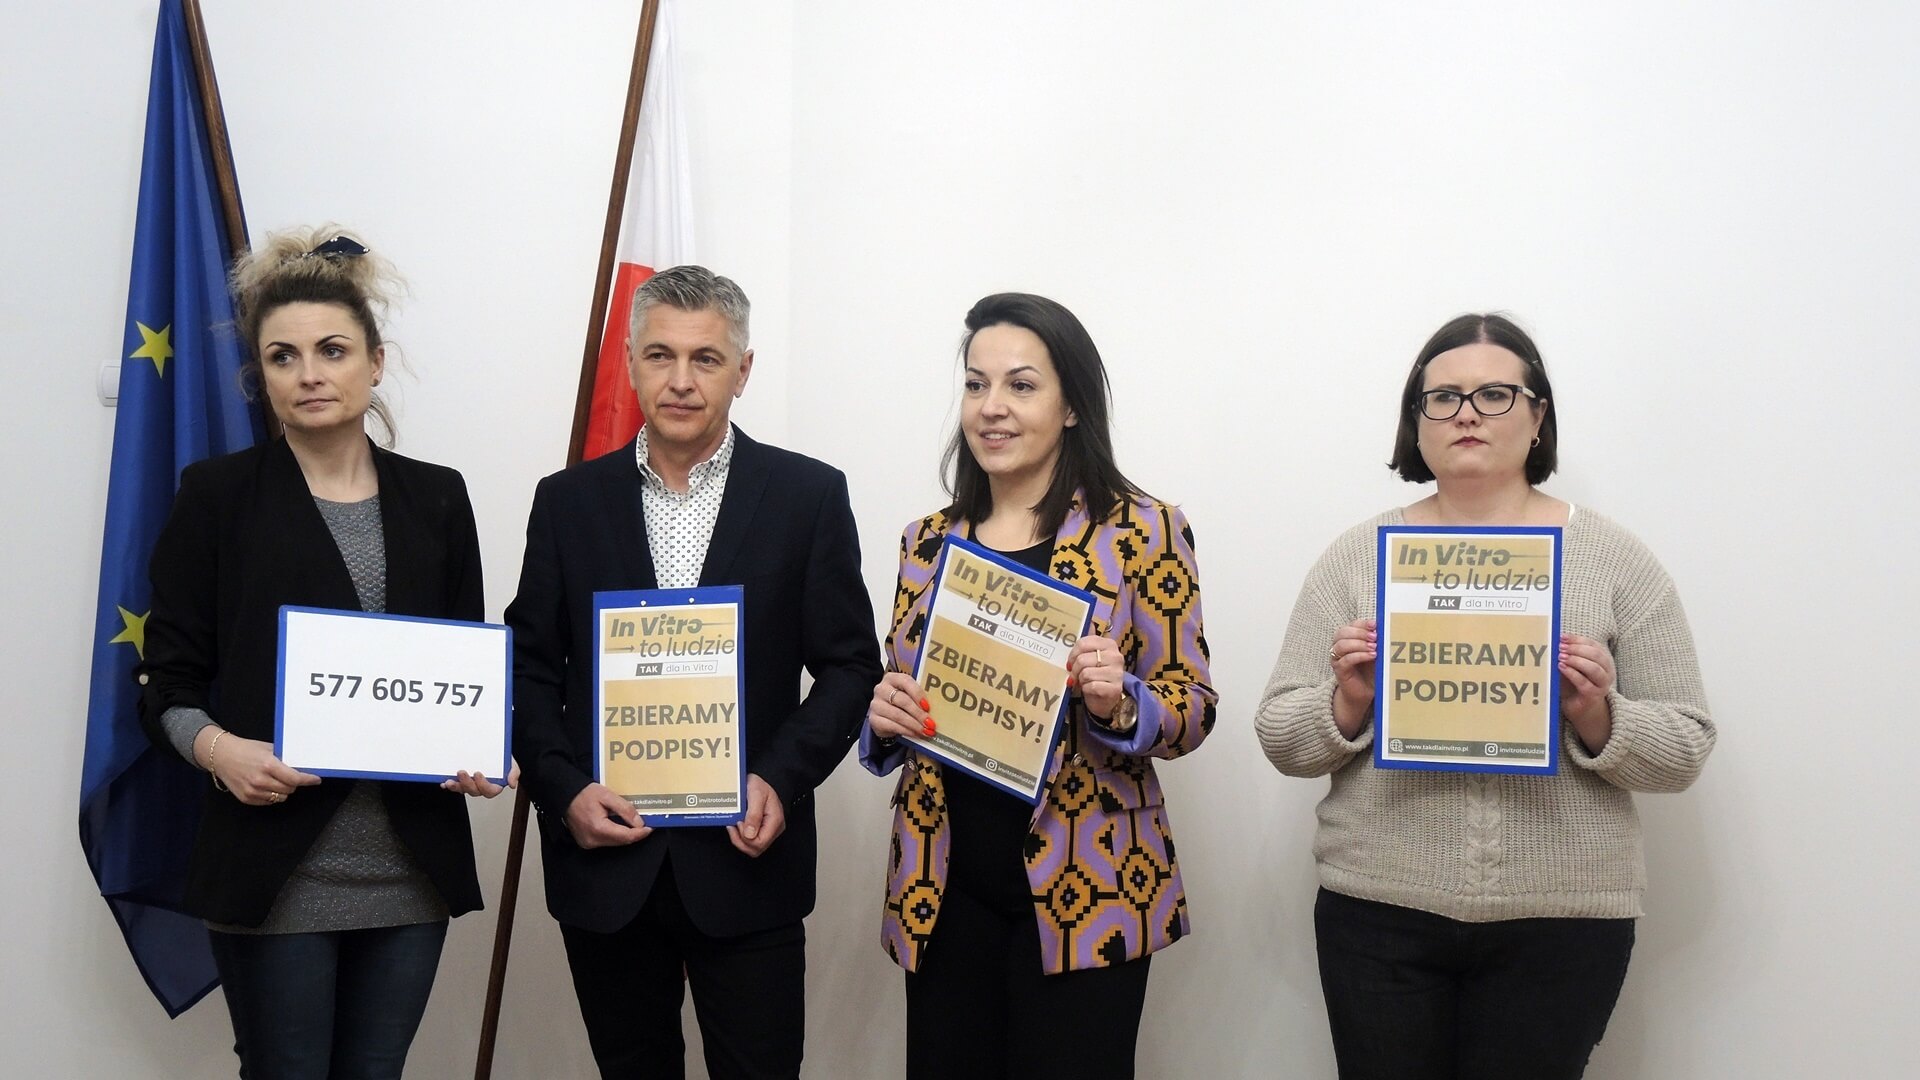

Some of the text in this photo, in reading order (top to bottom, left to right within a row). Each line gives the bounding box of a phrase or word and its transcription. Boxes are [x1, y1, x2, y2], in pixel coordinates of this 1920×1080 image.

[1398, 541, 1511, 567] In Vitro
[953, 558, 1050, 612] In Vitro
[1433, 567, 1550, 591] to ludzie
[1433, 598, 1523, 609] TAK dla In Vitro
[610, 613, 703, 638] In Vitro
[976, 592, 1077, 648] to ludzie
[639, 634, 735, 658] to ludzie
[973, 617, 1049, 656] TAK dla In Vitro
[1390, 641, 1548, 667] ZBIERAMY
[639, 663, 714, 674] TAK dla In Vitro
[927, 640, 1060, 712] ZBIERAMY
[309, 672, 484, 707] 577 605 757
[1395, 679, 1540, 706] PODPISY!
[604, 702, 736, 727] ZBIERAMY
[924, 673, 1045, 744] PODPISY!
[609, 736, 731, 761] PODPISY!
[1405, 744, 1469, 753] www.takdlainvitro.pl
[1499, 746, 1545, 756] invitrotoludzie
